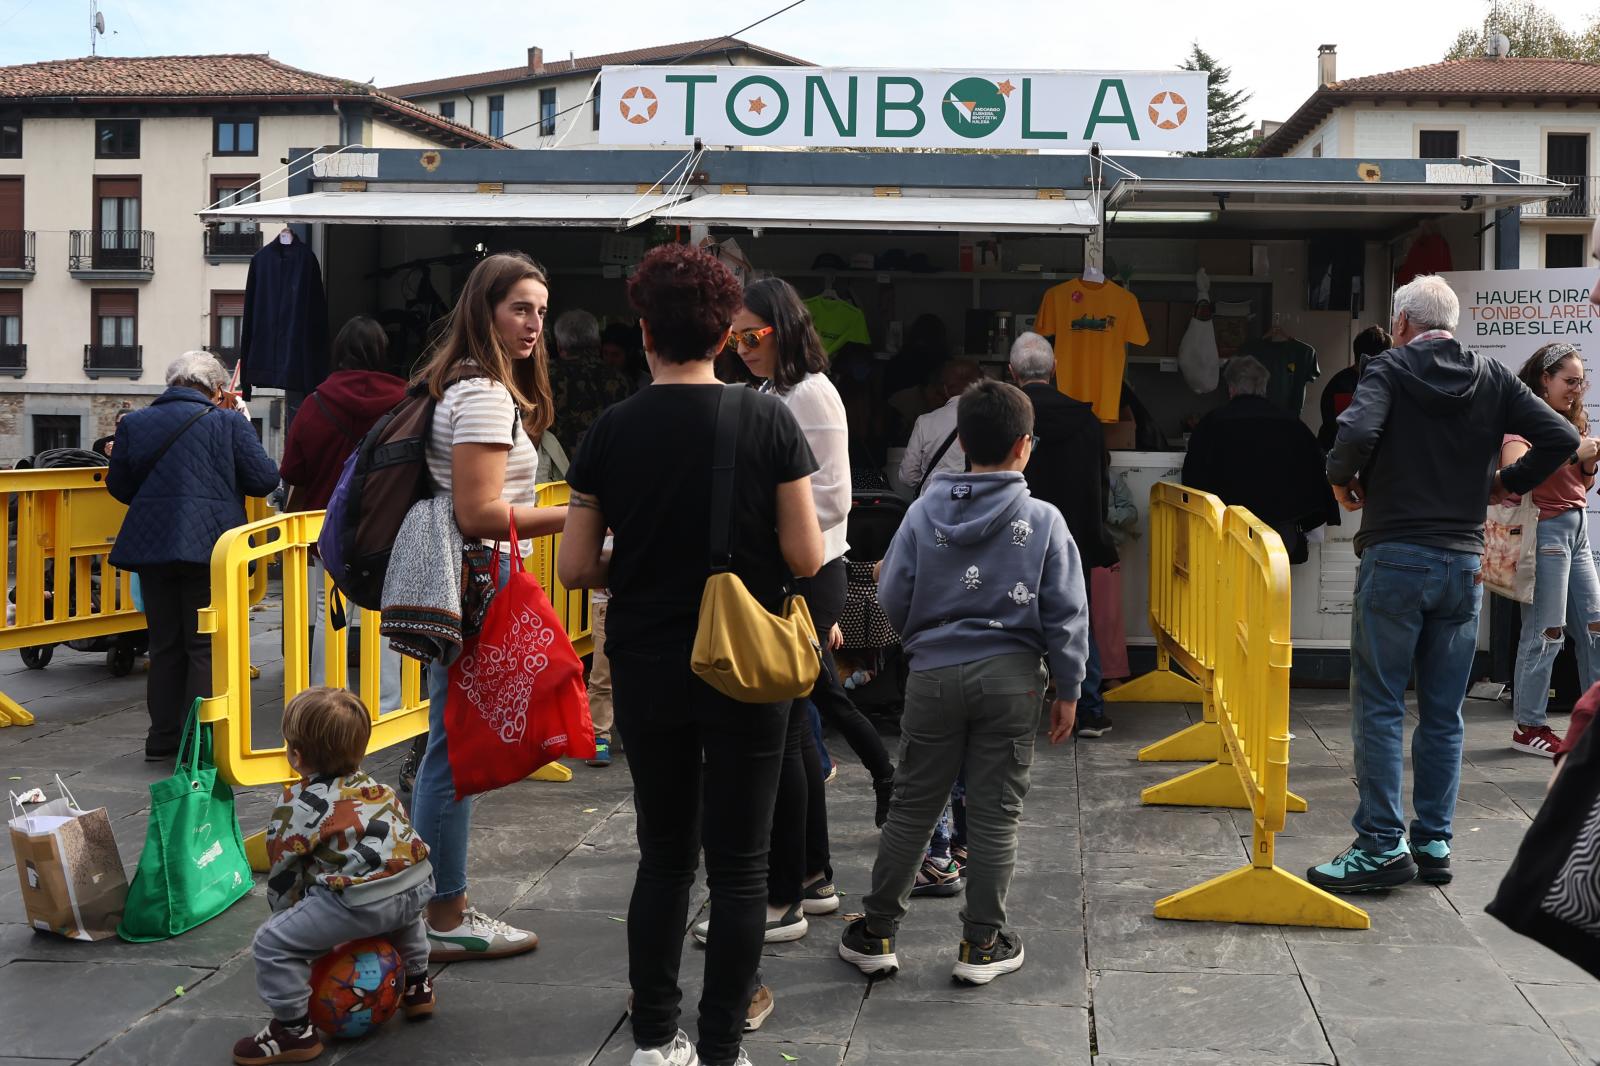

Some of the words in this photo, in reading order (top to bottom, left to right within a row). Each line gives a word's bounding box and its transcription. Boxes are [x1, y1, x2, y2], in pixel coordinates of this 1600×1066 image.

[665, 75, 1140, 141] TONBOLA
[1476, 289, 1542, 305] HAUEK
[1548, 288, 1590, 304] DIRA
[1469, 304, 1600, 321] TONBOLAREN
[1476, 320, 1593, 336] BABESLEAK
[1382, 853, 1405, 867] SALOMON
